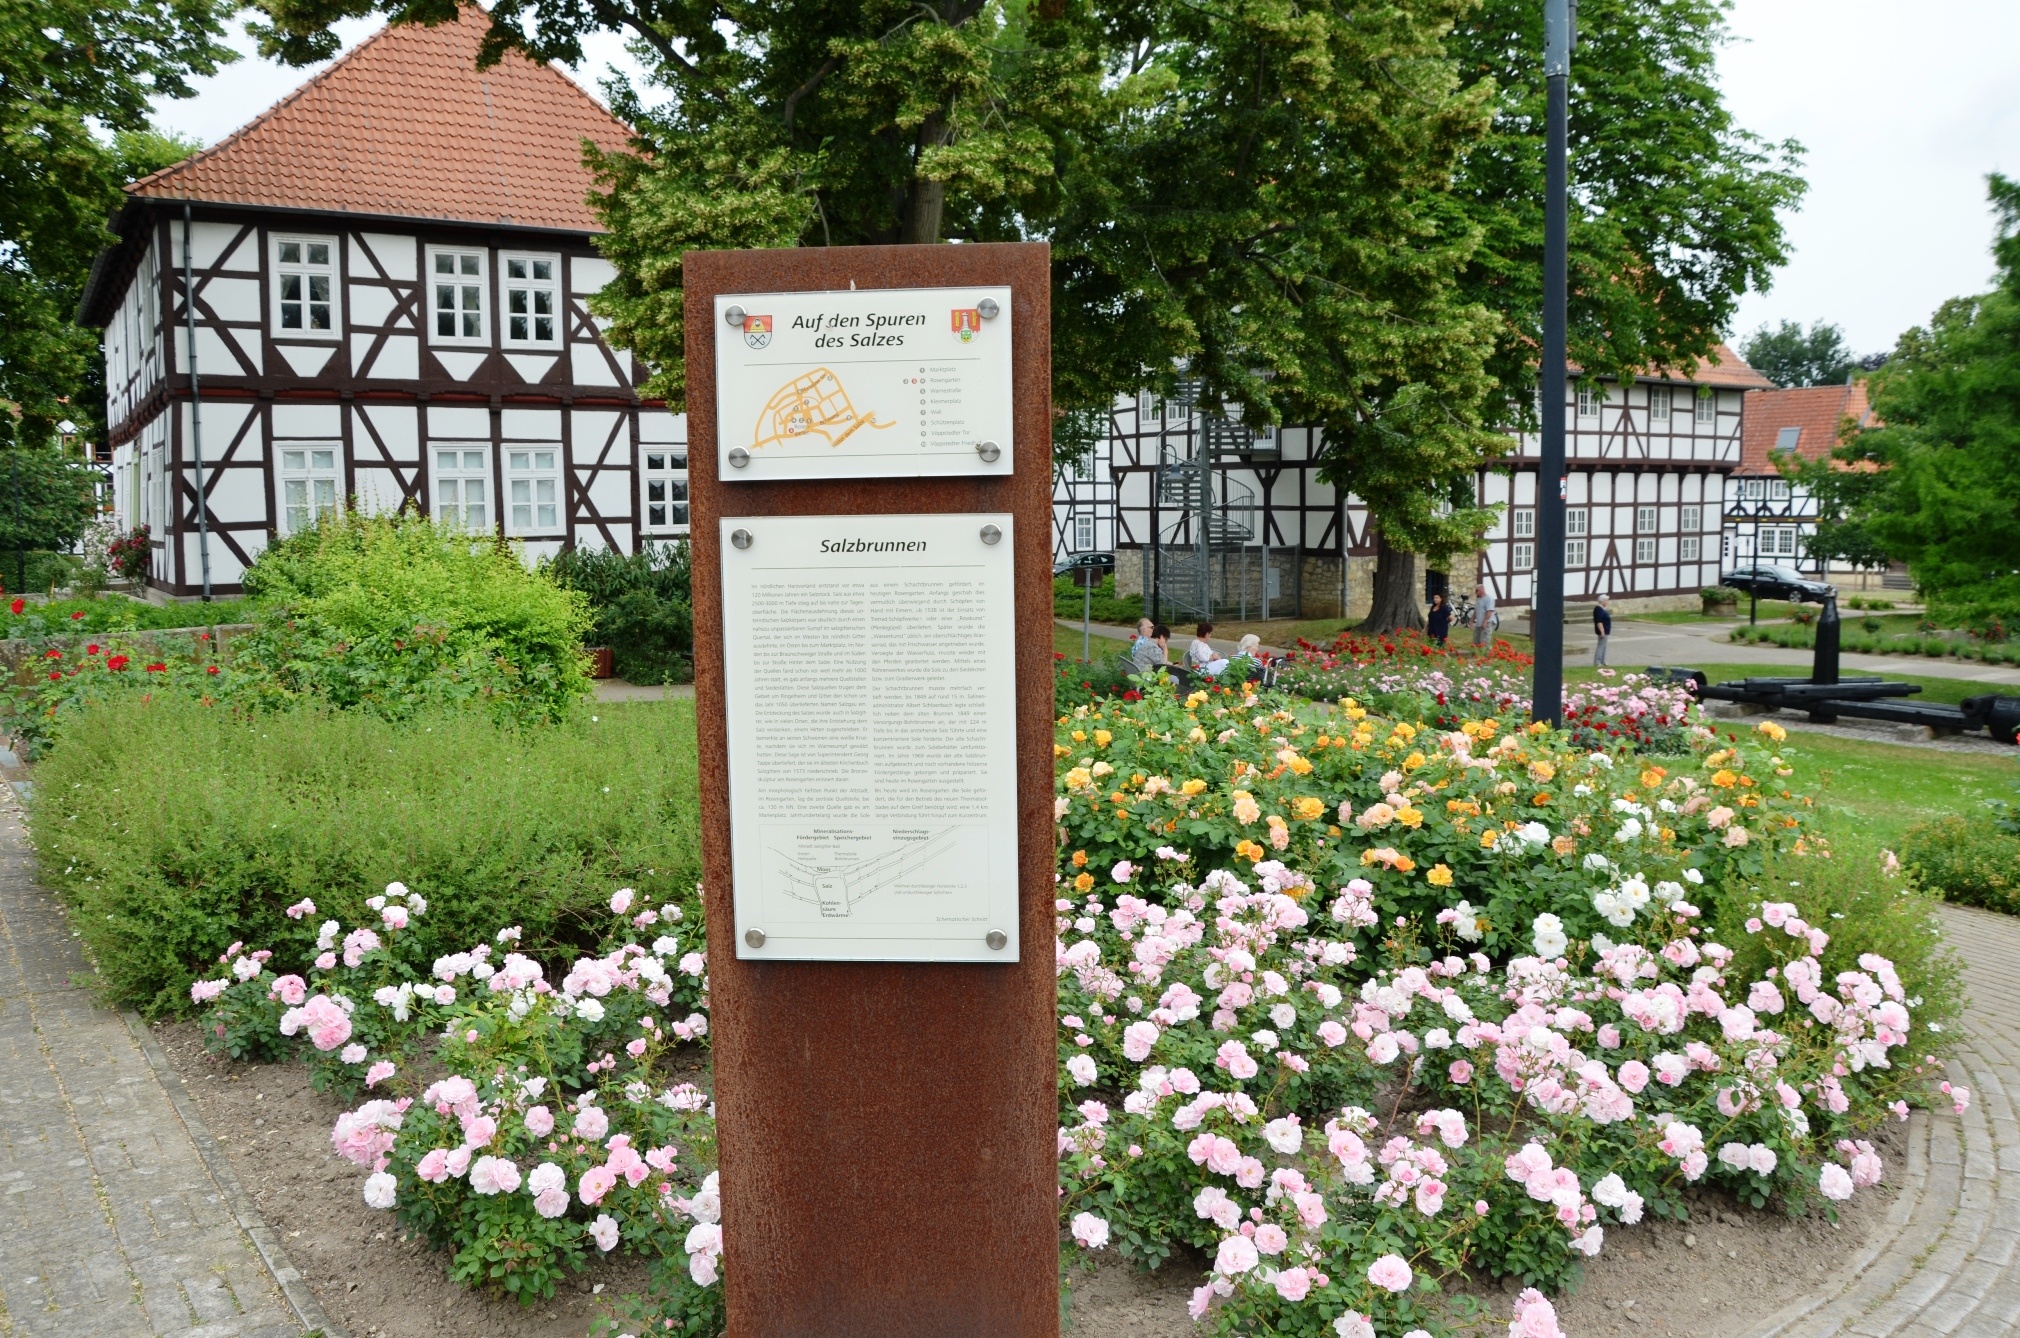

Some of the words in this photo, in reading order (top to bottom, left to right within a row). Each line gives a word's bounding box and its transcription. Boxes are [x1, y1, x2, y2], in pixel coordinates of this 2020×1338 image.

[792, 314, 824, 332] Auf
[828, 314, 860, 328] den
[866, 313, 926, 330] Spuren
[815, 334, 844, 348] des
[850, 332, 904, 347] Salzes
[820, 538, 926, 552] Salzbrunnen
